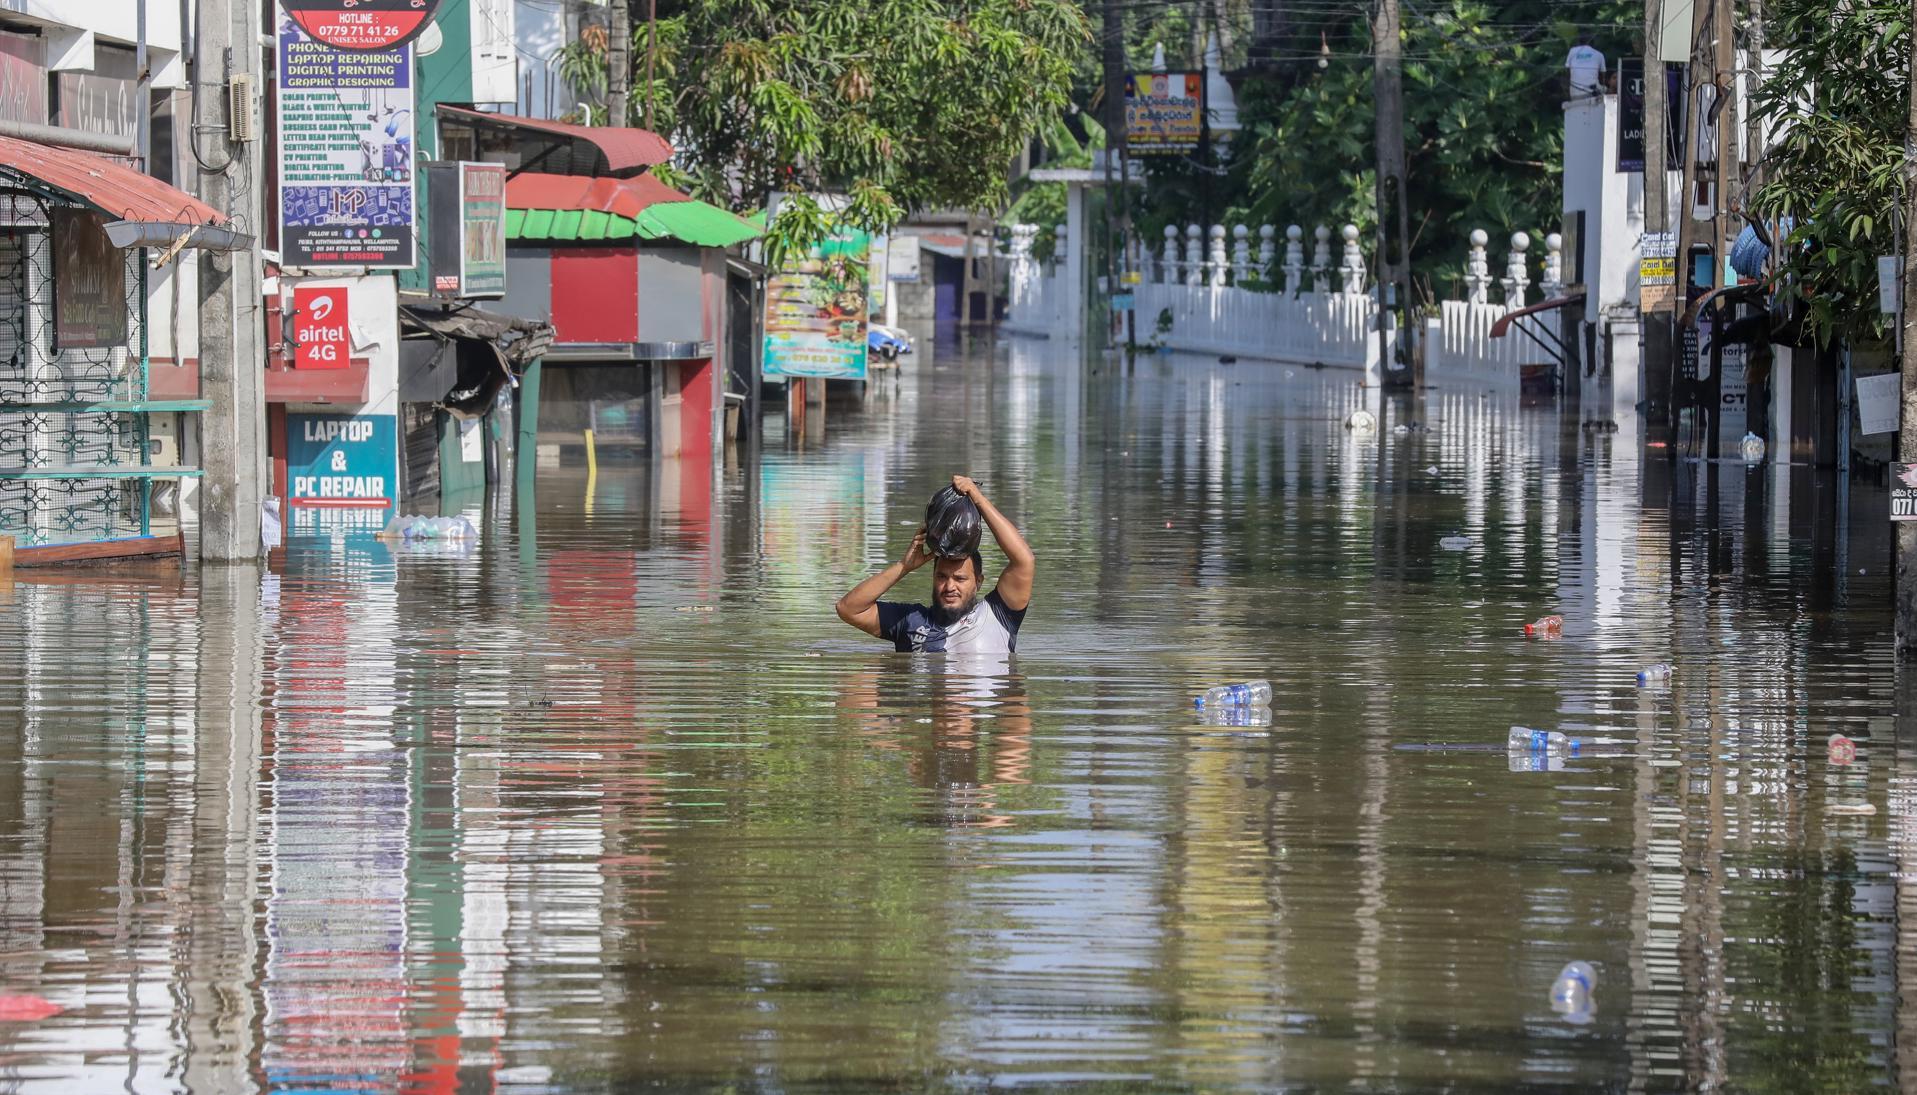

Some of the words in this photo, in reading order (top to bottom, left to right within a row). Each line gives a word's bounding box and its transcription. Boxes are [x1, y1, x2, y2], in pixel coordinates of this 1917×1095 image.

[339, 13, 373, 24] HOTLINE
[318, 26, 348, 36] 0779
[350, 26, 363, 36] 71
[367, 26, 381, 36] 41
[384, 26, 399, 36] 26
[288, 43, 329, 53] PHONE
[288, 55, 335, 64] LAPTOP
[338, 54, 403, 64] REPAIRING
[288, 66, 335, 75] DIGITAL
[338, 66, 395, 75] PRINTING
[288, 78, 335, 87] GRAPHIC
[337, 77, 395, 87] DESIGNING
[283, 133, 306, 141] LETTER
[283, 143, 326, 151] CERTIFICATE
[299, 325, 345, 342] airtel
[308, 345, 337, 361] 4G
[304, 420, 373, 442] LAPTOP
[331, 450, 347, 471] &
[294, 476, 316, 497] PC
[320, 476, 384, 497] REPAIR
[1892, 498, 1912, 515] 077
